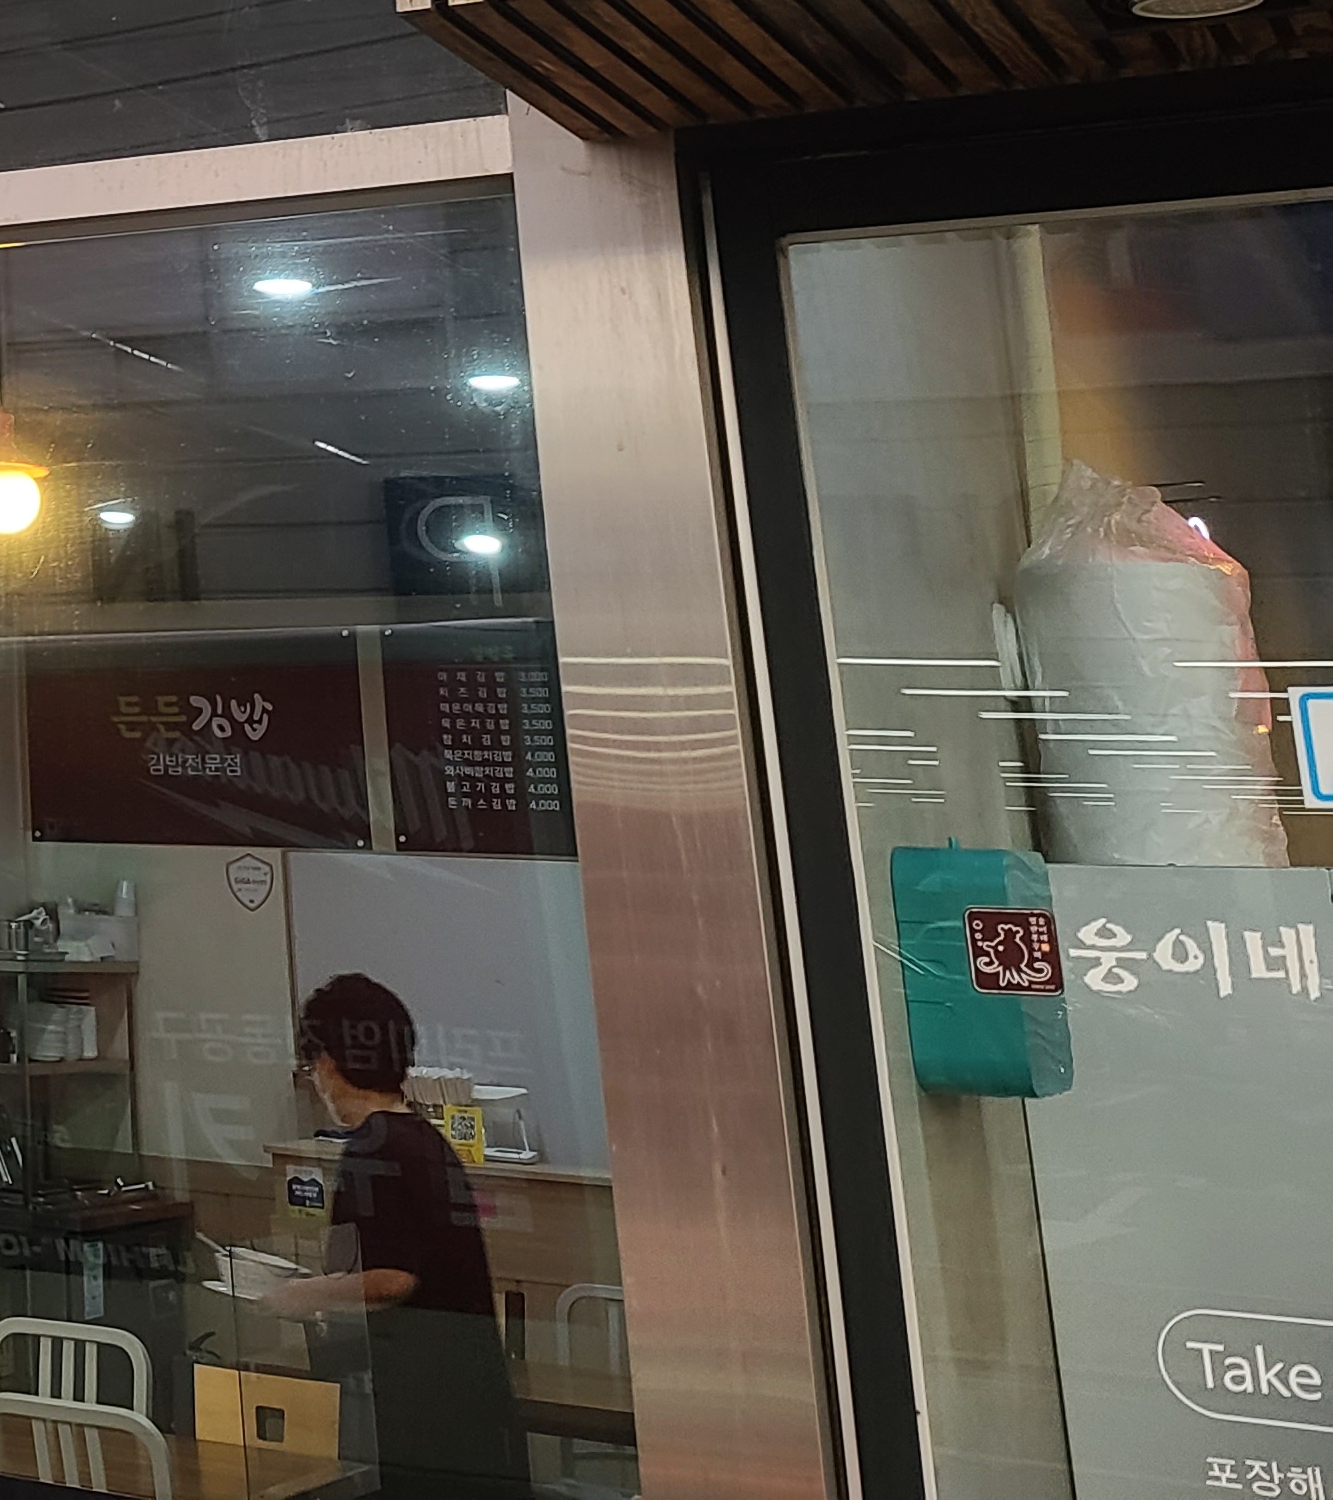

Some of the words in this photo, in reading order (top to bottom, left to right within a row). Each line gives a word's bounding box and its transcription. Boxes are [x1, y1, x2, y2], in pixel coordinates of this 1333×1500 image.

[110, 692, 274, 741] 든든김밥
[147, 753, 242, 776] 김밥전문점
[1067, 917, 1322, 1001] 웅이네
[1185, 1340, 1323, 1401] Take
[1205, 1456, 1326, 1500] 포장해
